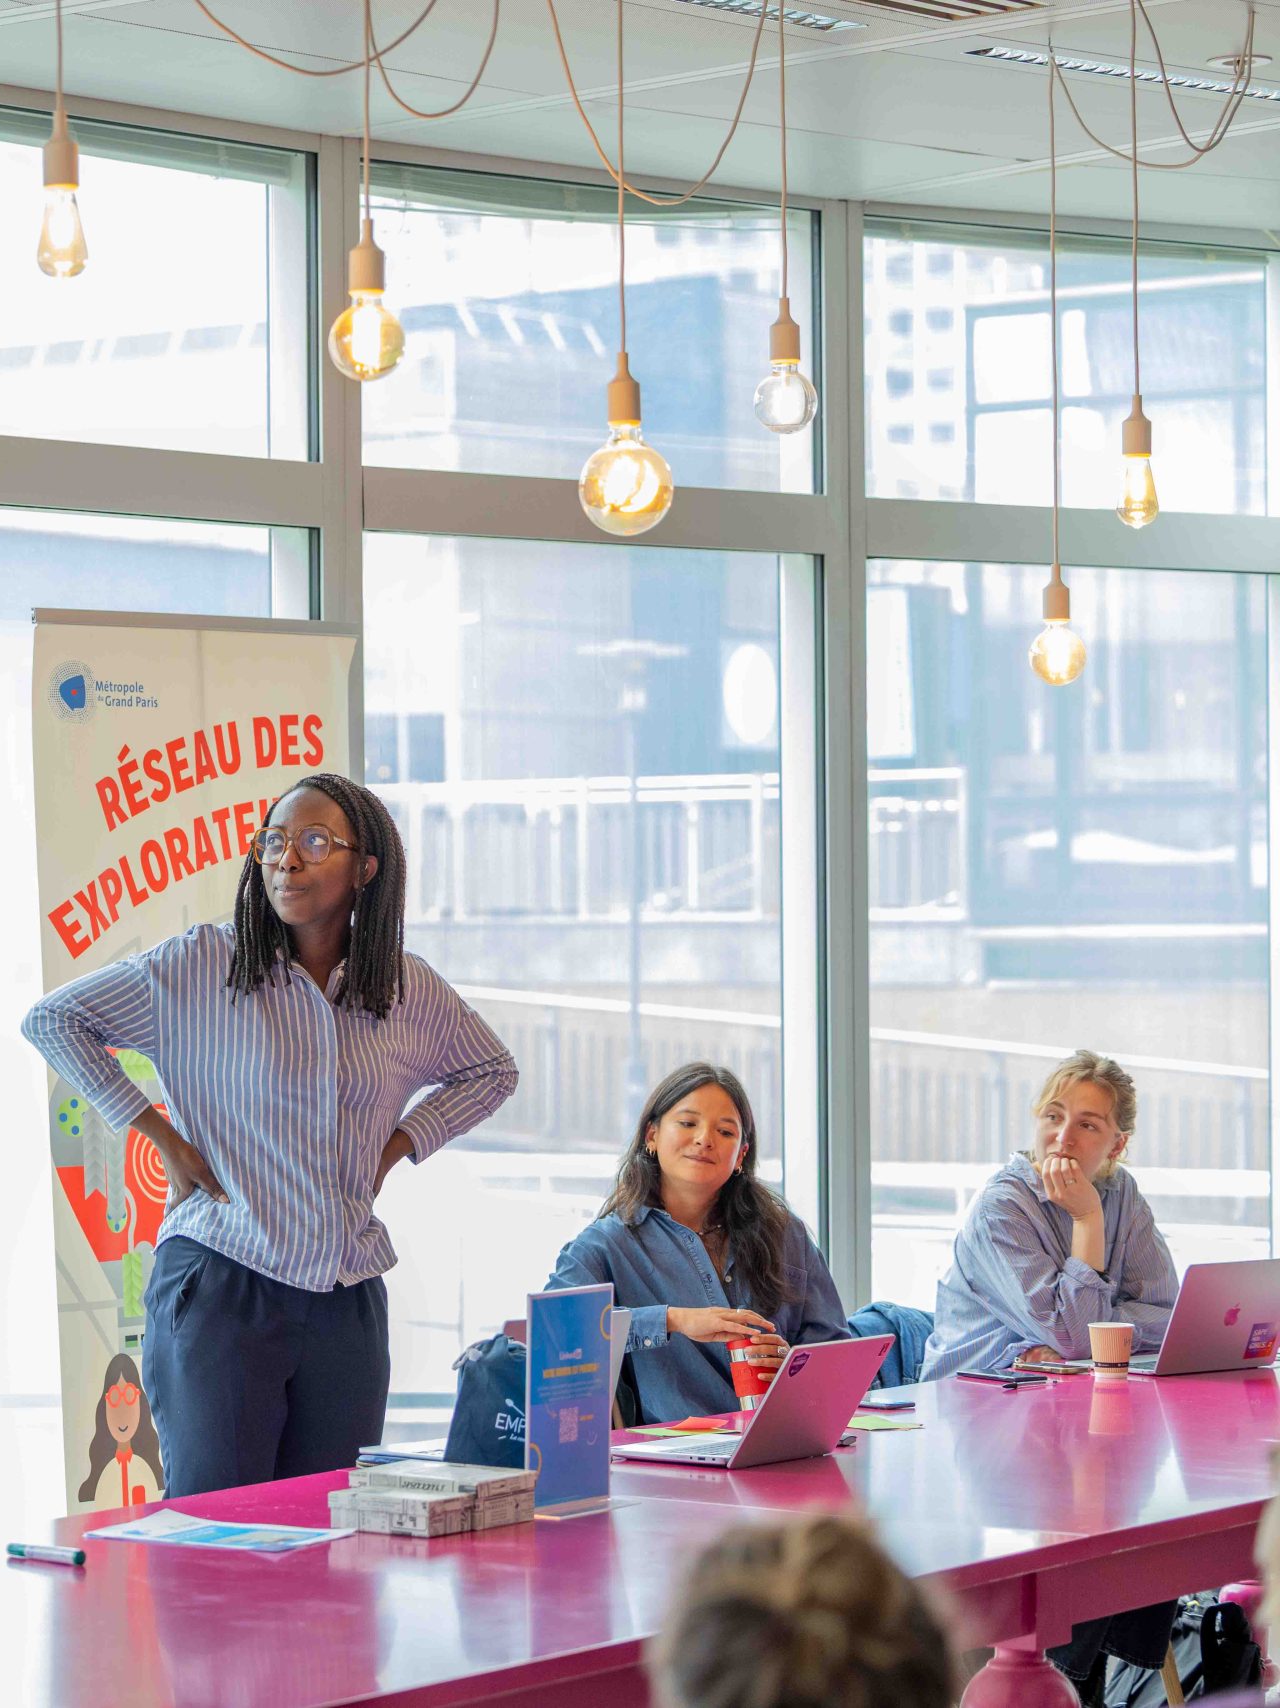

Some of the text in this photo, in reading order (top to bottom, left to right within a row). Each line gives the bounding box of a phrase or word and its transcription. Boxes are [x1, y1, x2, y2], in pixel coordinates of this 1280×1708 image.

[95, 681, 144, 695] Métropole
[105, 696, 133, 707] Grand
[136, 697, 158, 708] Paris
[95, 714, 324, 832] RÉSEAU DES
